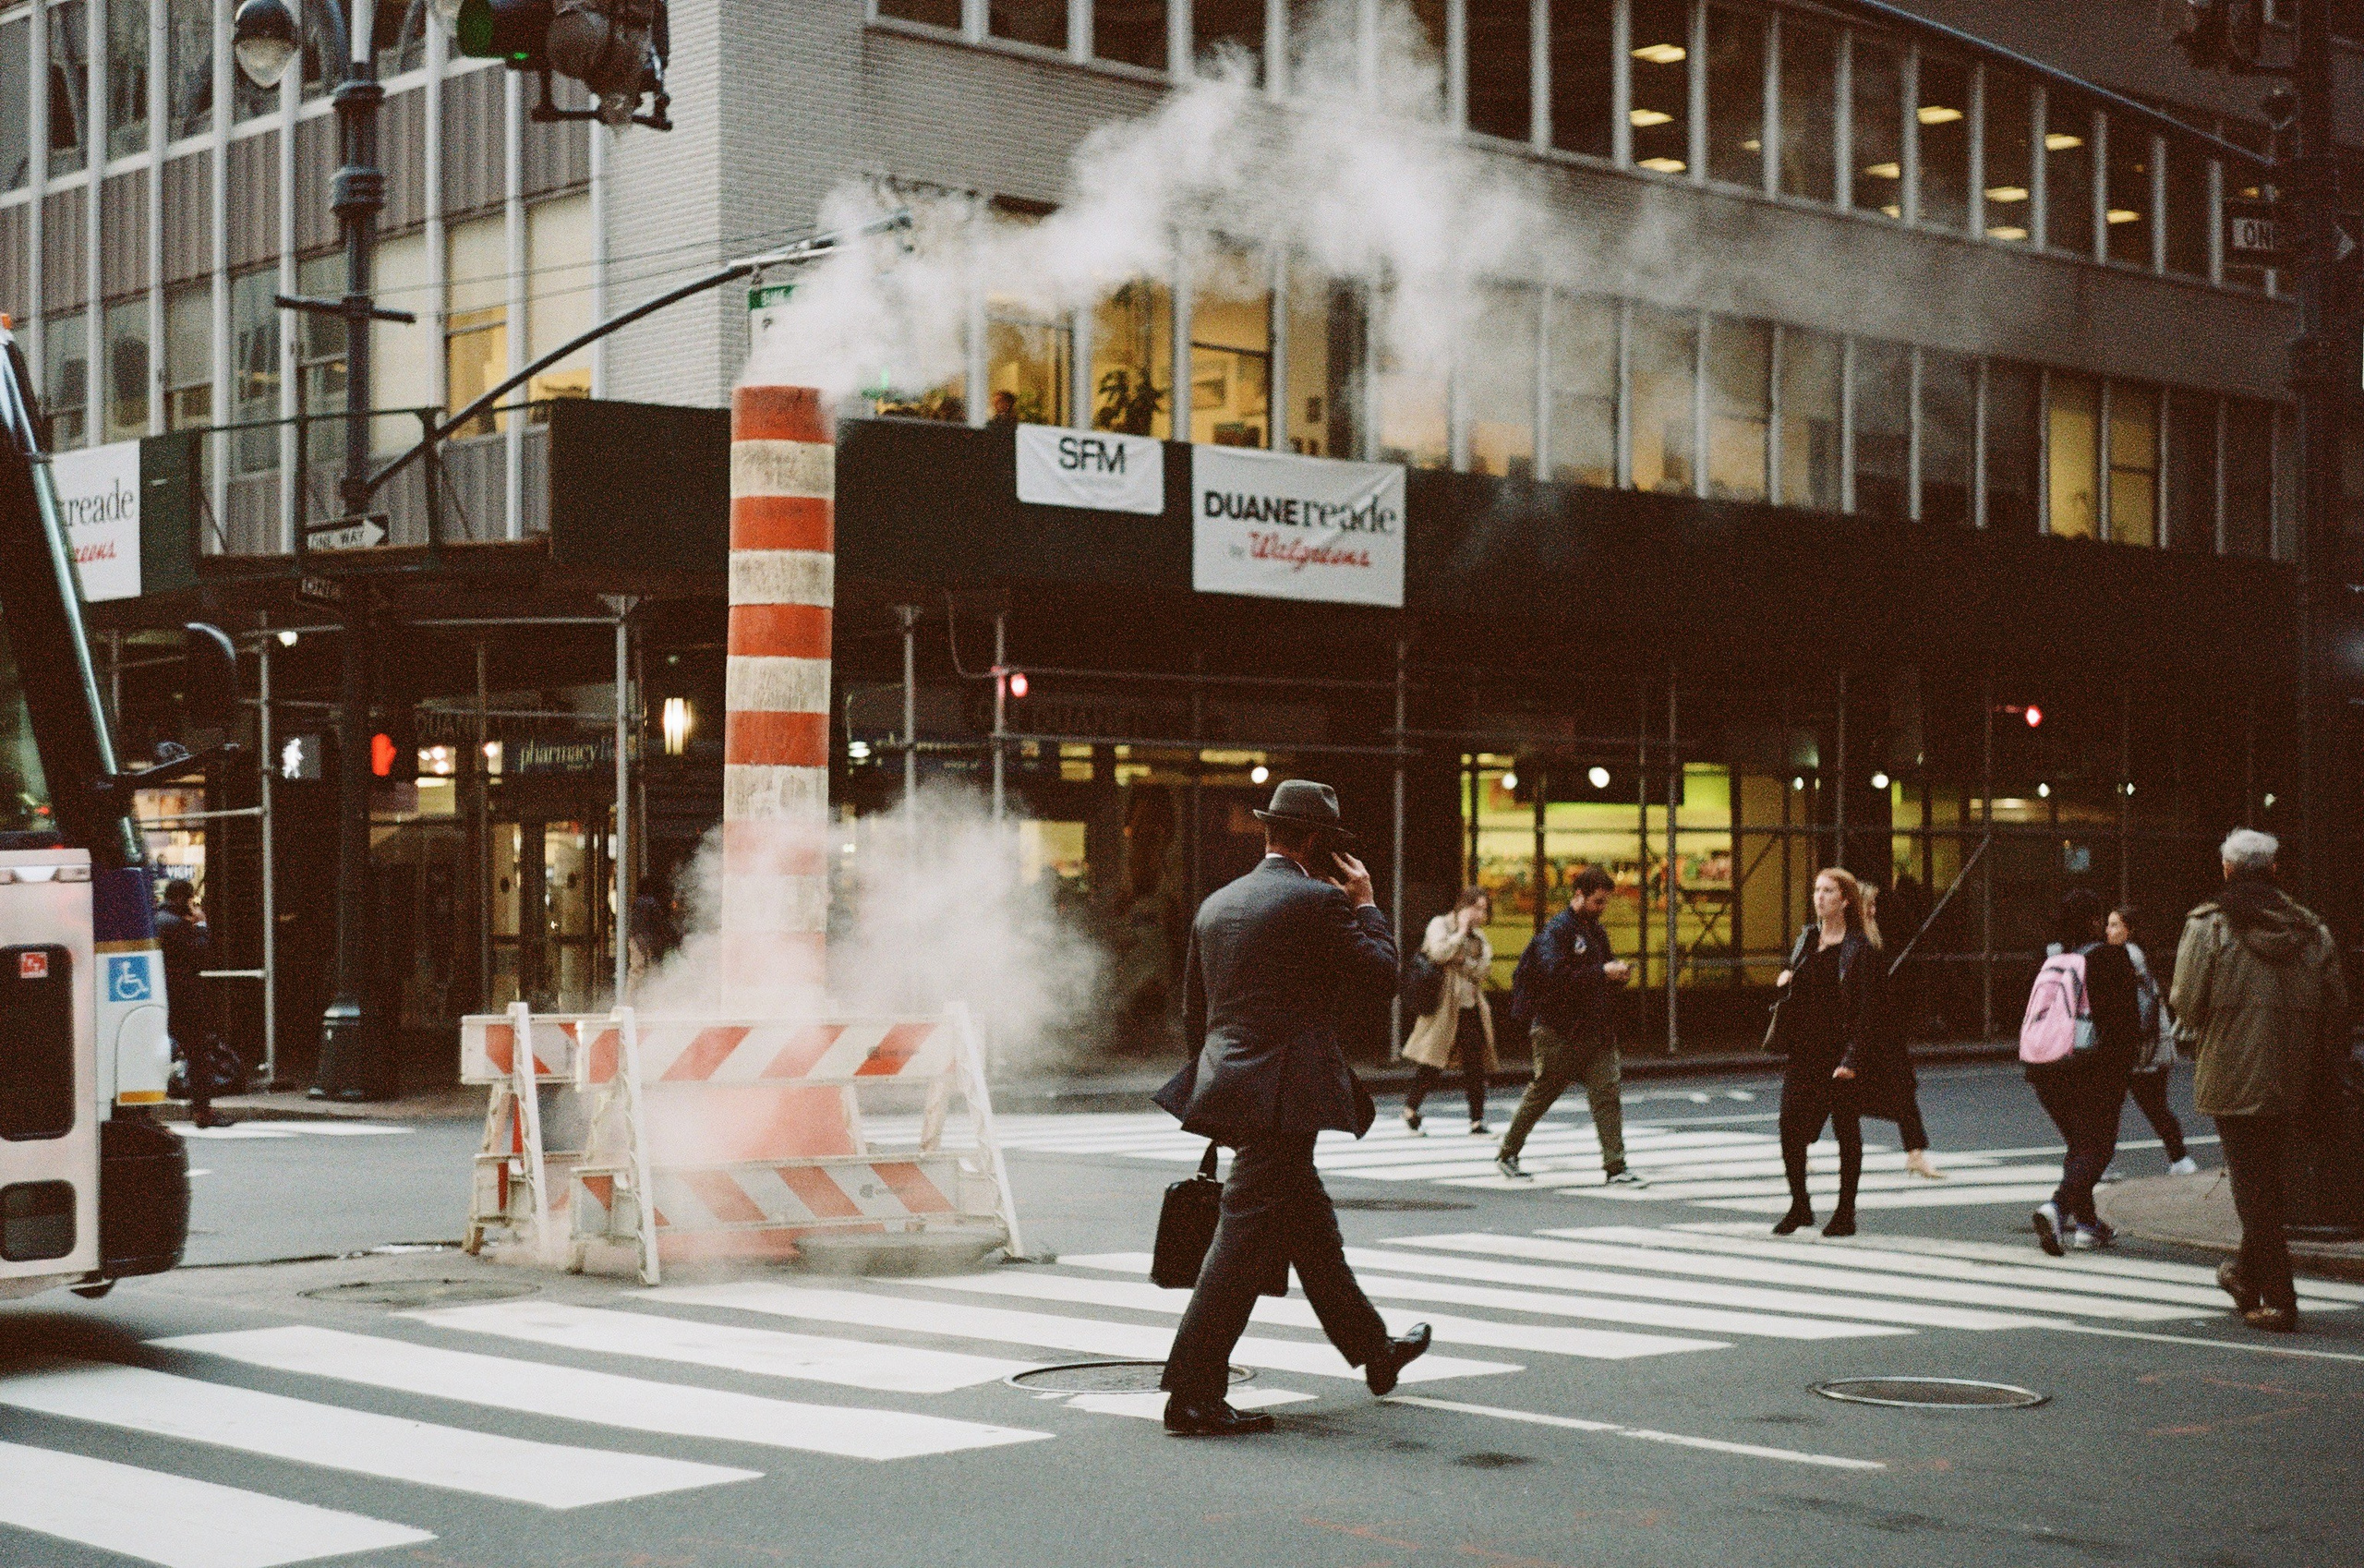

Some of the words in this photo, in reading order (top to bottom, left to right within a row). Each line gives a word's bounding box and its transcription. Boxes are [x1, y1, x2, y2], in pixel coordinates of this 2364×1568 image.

[2243, 219, 2274, 250] ON
[1058, 436, 1126, 475] SFM
[61, 478, 134, 527] reade
[340, 528, 365, 547] WAY
